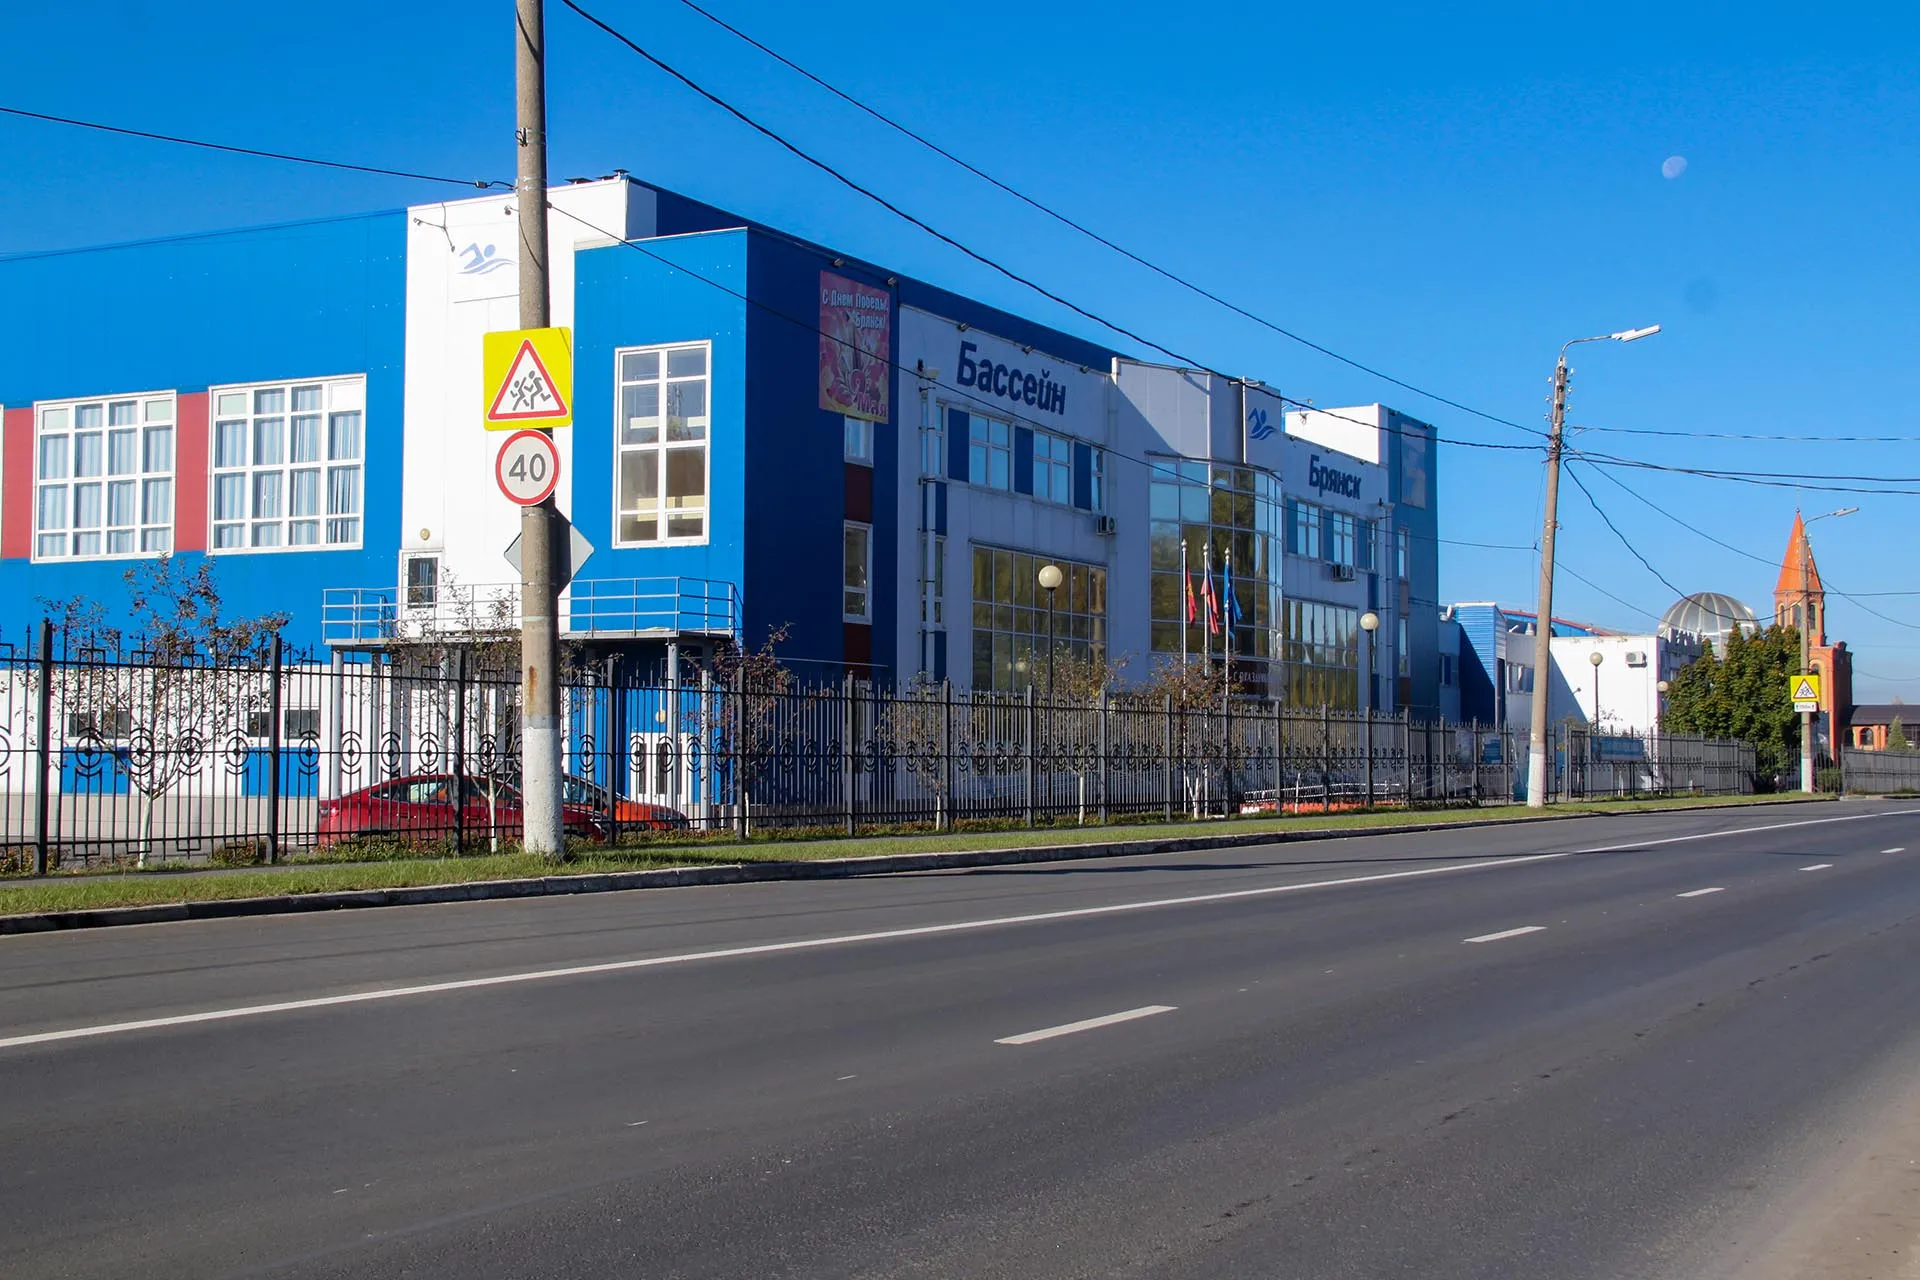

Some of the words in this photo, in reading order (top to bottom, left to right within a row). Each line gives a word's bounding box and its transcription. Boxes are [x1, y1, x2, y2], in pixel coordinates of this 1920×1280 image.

[822, 288, 829, 305] С
[957, 340, 1066, 415] Бассейн
[508, 452, 547, 483] 40
[1308, 453, 1362, 500] Брянск
